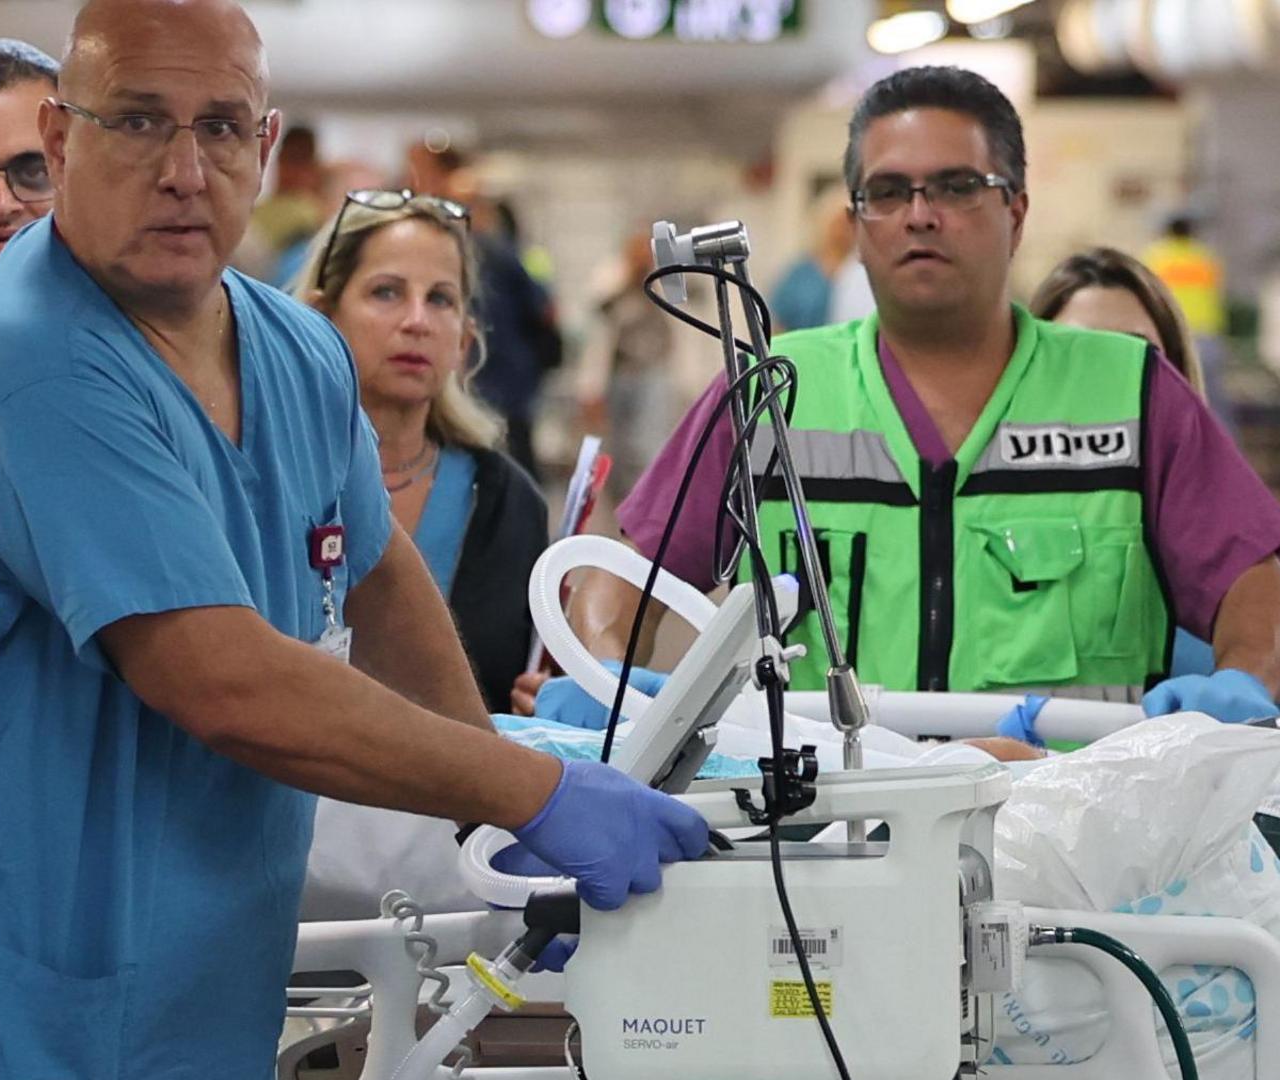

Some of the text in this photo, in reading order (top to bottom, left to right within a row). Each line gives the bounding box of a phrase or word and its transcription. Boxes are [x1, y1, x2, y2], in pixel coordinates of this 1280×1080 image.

[1009, 431, 1125, 461] שינוע
[622, 1018, 707, 1036] MAQUET
[623, 1039, 680, 1050] SERVO-air
